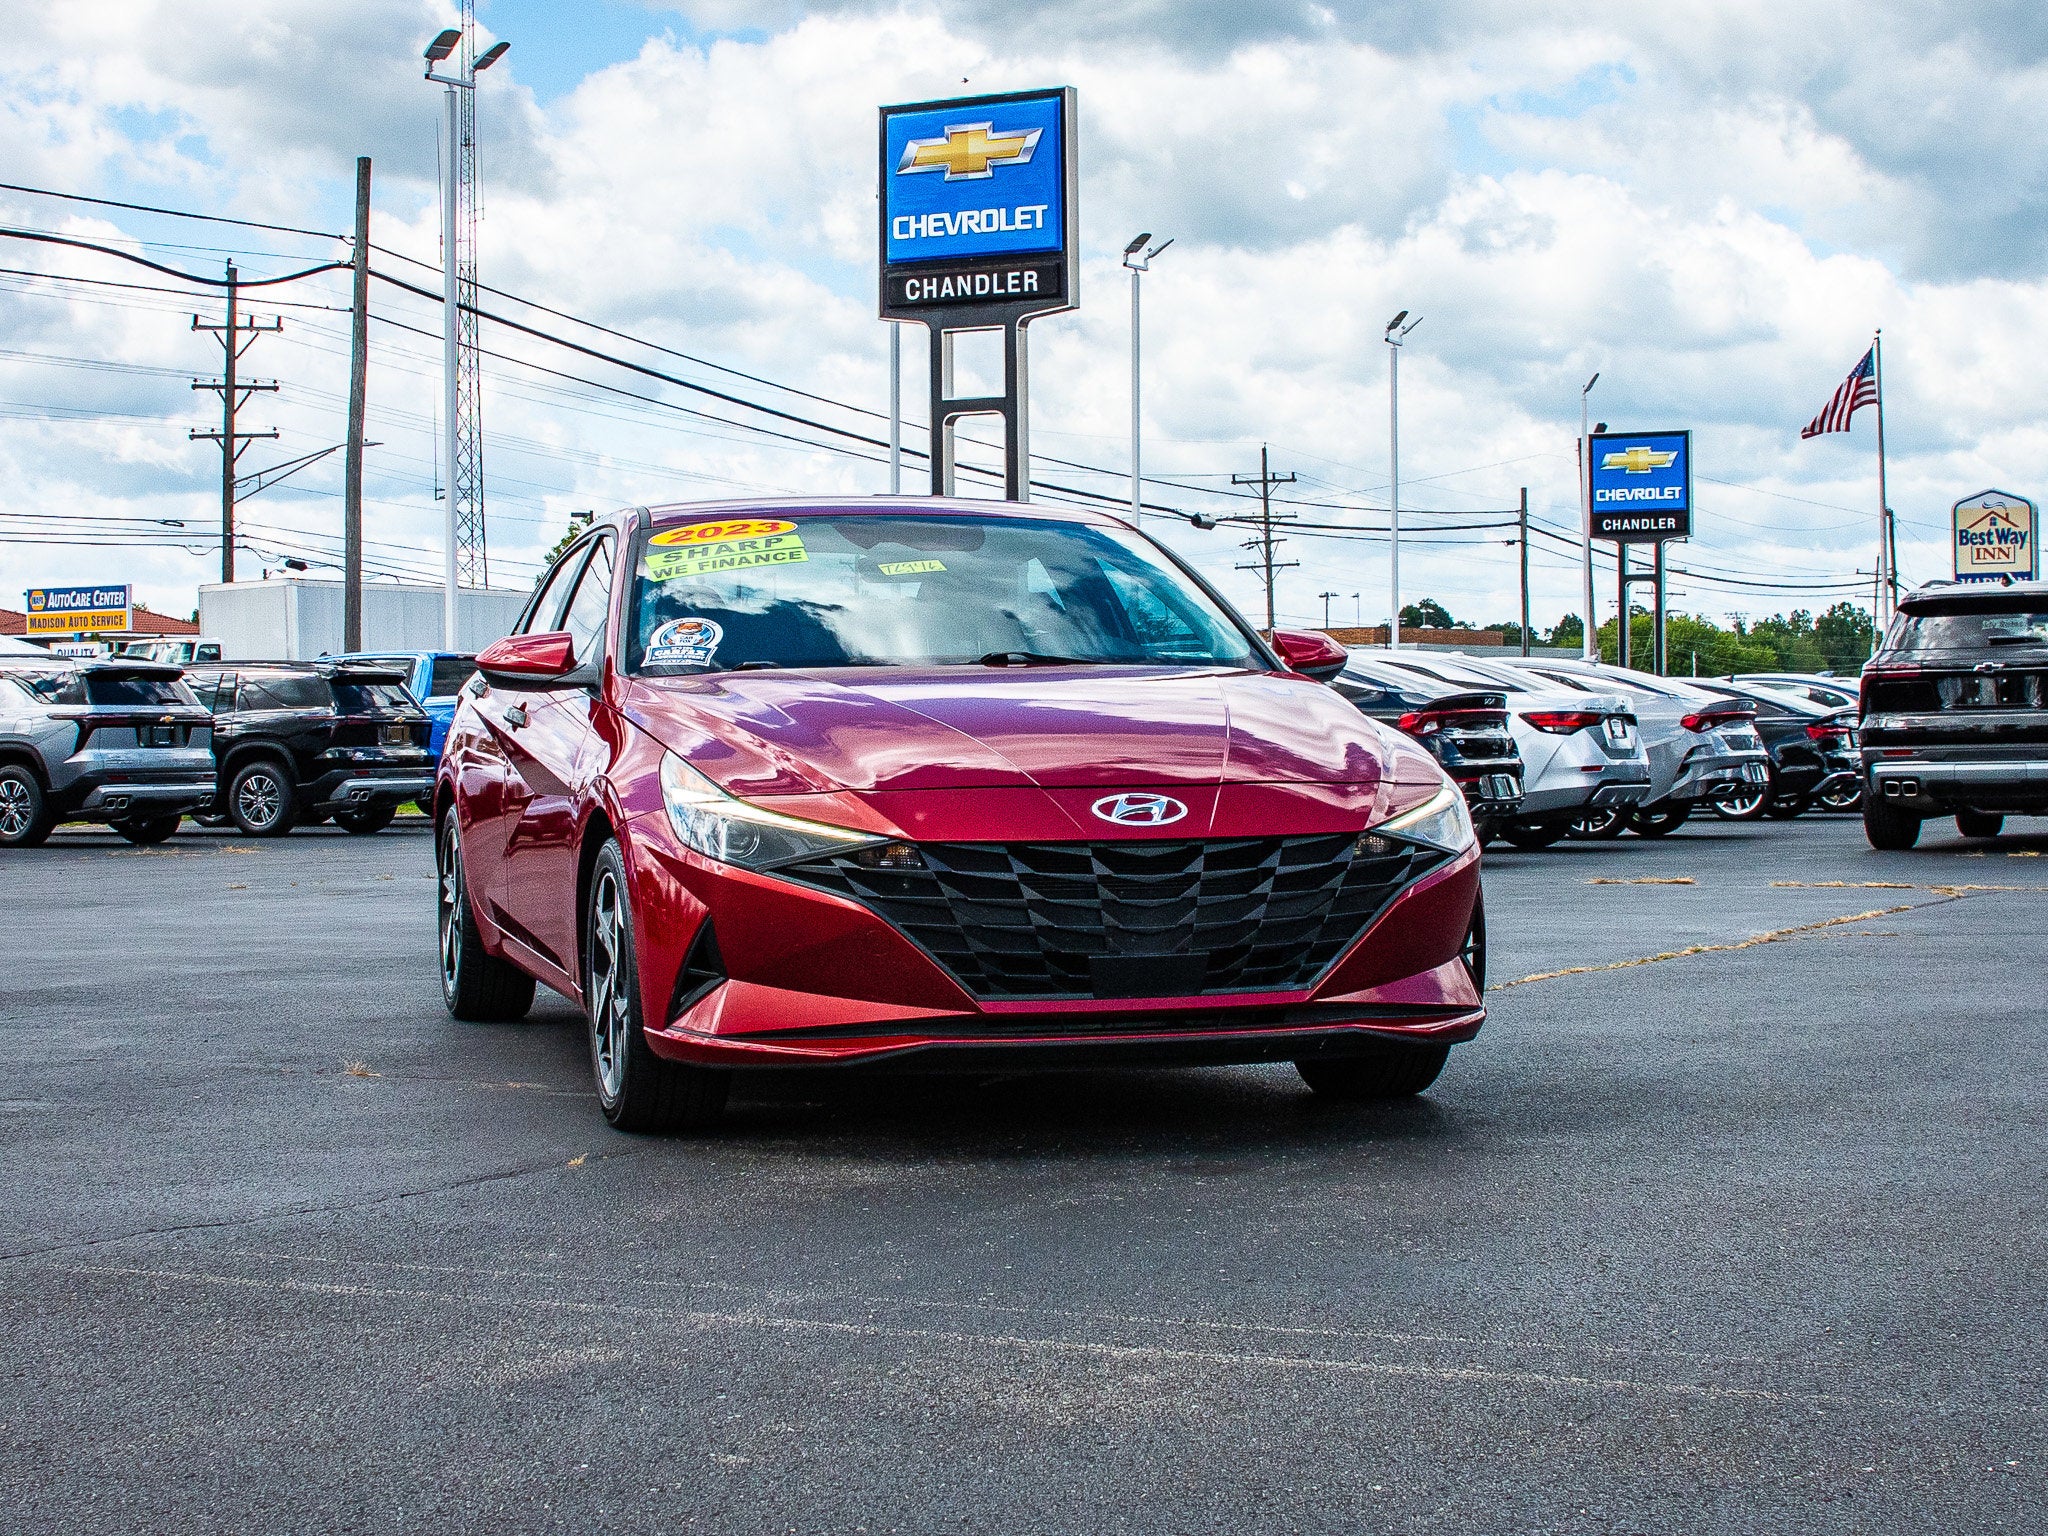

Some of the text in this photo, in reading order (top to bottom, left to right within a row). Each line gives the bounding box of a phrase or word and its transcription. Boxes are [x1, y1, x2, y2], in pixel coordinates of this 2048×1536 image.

[892, 204, 1048, 240] CHEVROLET
[905, 270, 1038, 300] CHANDLER
[1595, 486, 1683, 502] CHEVROLET
[666, 522, 780, 544] 2023
[1602, 517, 1676, 531] CHANDLER
[1958, 527, 2028, 550] Best Way
[663, 537, 784, 563] SHARP
[1975, 547, 2012, 560] INN
[653, 550, 802, 579] WE FINANCE
[93, 589, 125, 606] CENTER
[30, 614, 124, 629] MADISON AUTO SERVICE
